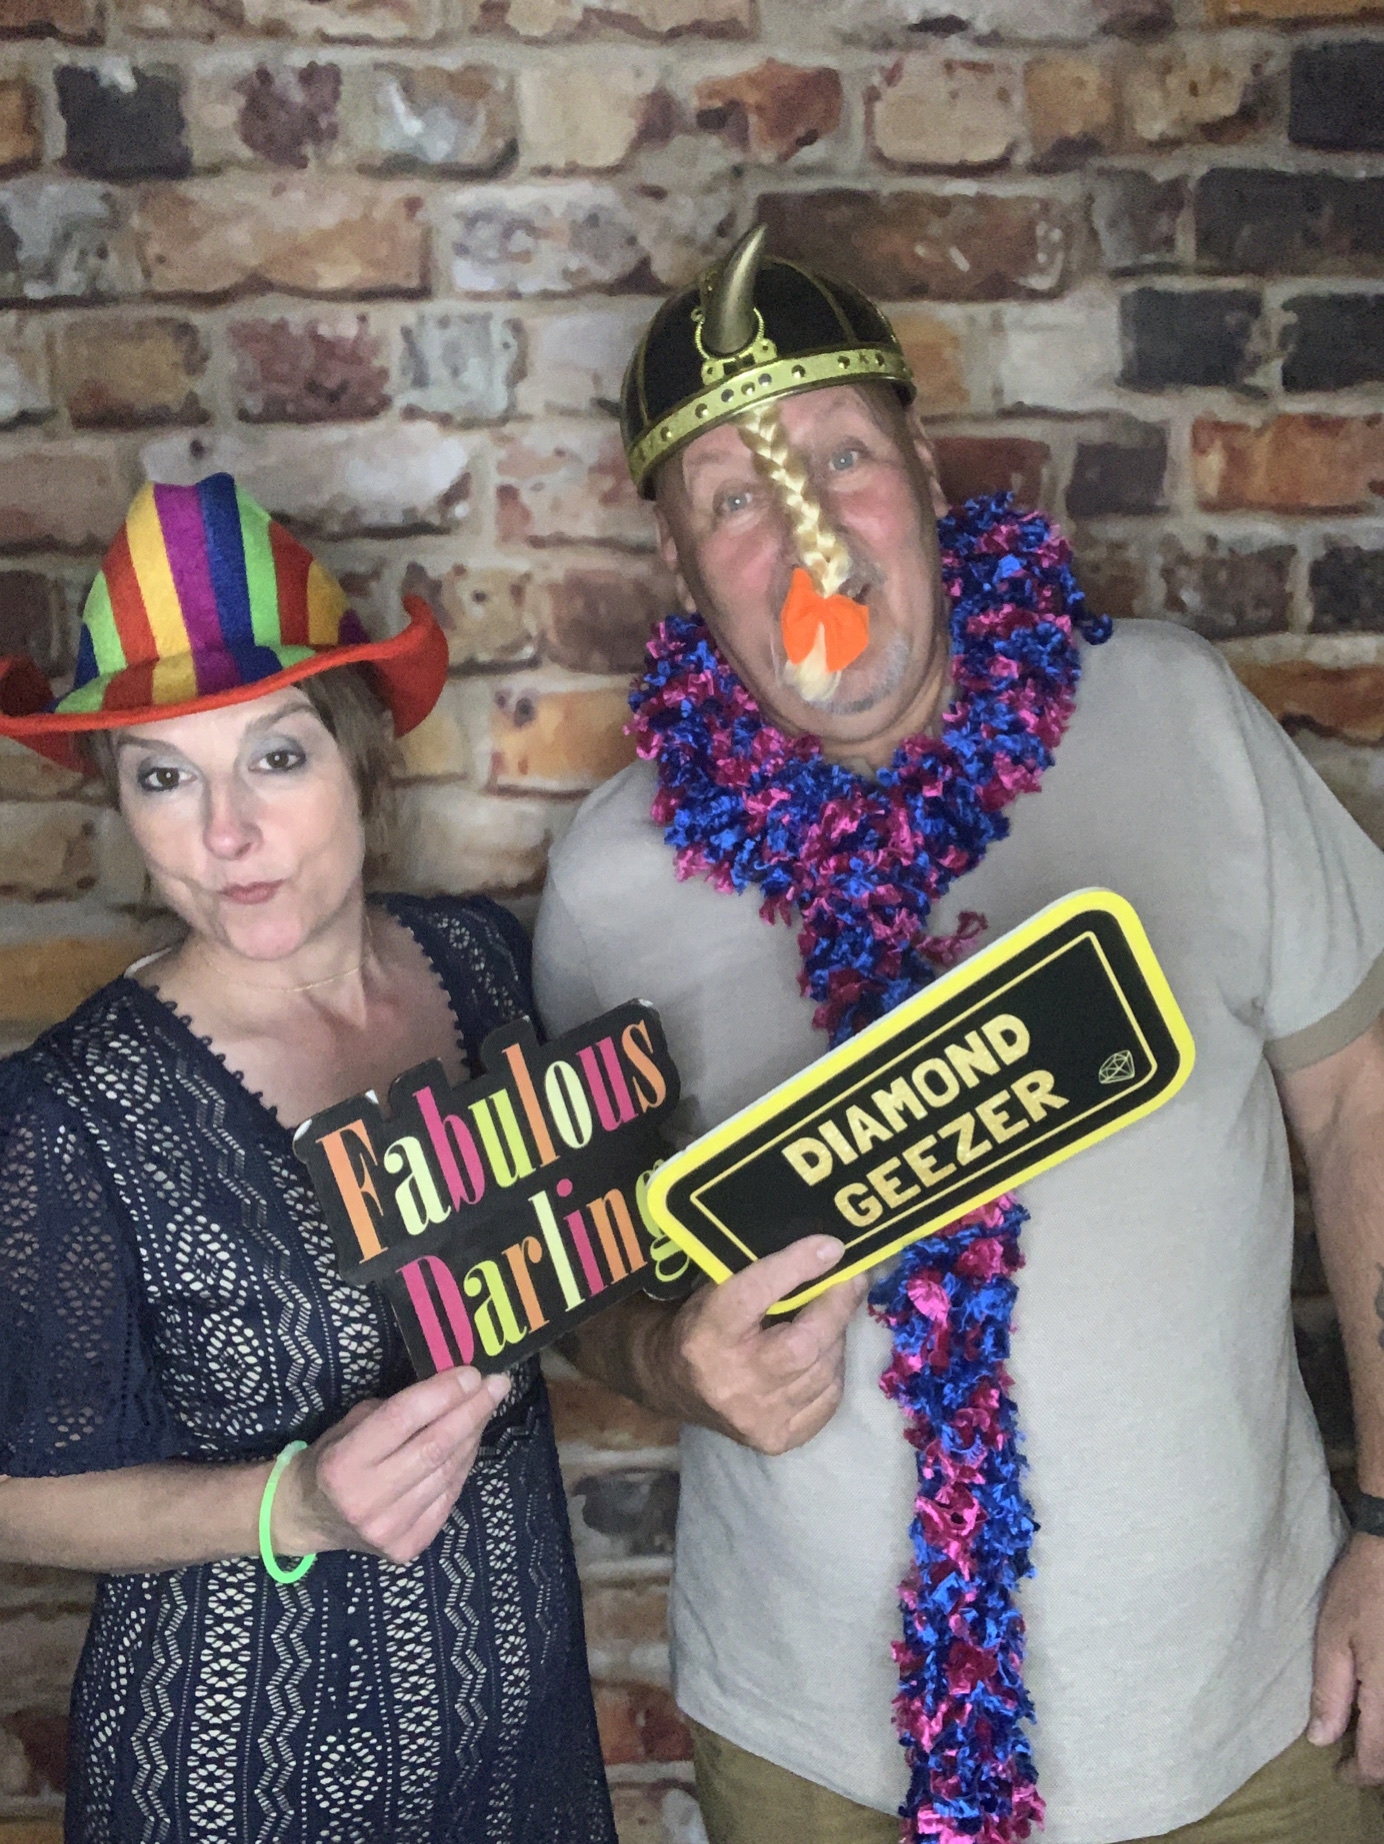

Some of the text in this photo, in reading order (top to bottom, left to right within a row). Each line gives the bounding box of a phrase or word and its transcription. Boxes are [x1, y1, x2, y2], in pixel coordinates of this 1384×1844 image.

[315, 1020, 667, 1264] Fabulous
[782, 1013, 1031, 1186] DIAMOND
[833, 1070, 1070, 1228] GEEZER
